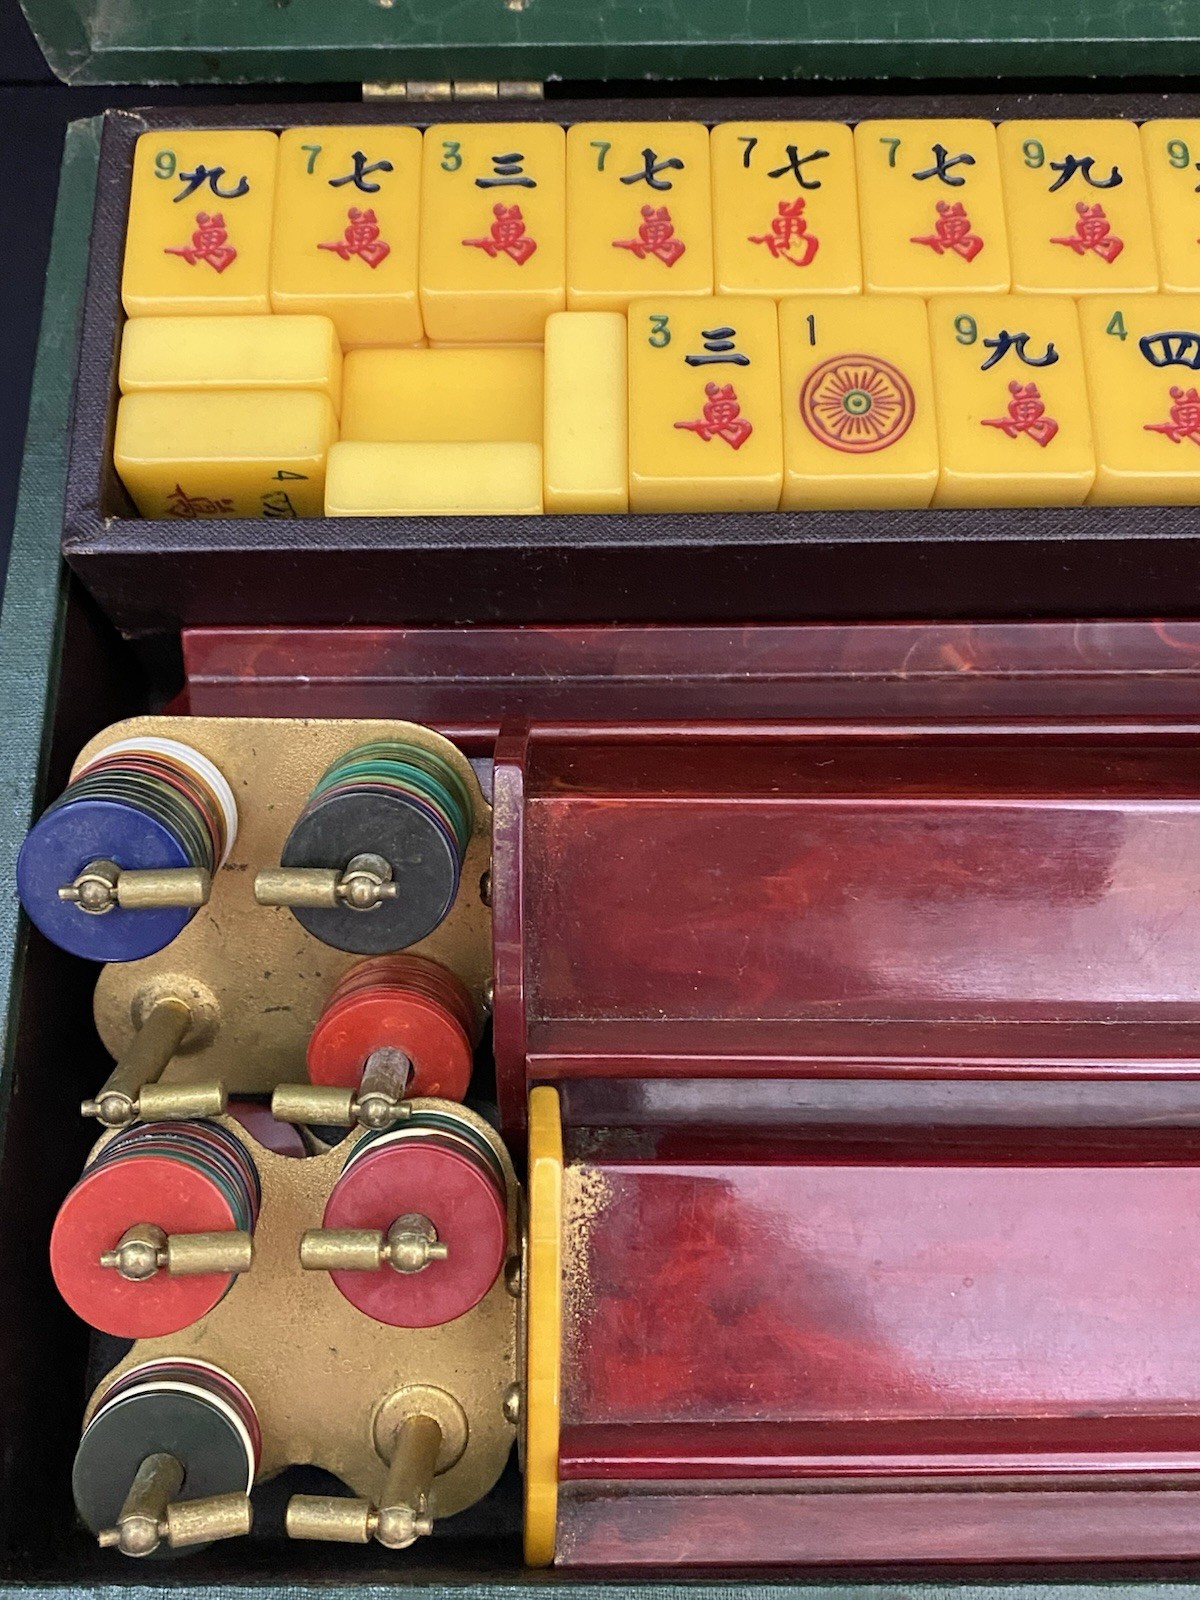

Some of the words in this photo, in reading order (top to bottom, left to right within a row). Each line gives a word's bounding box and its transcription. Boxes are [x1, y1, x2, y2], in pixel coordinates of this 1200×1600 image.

[154, 150, 177, 180] 9
[301, 145, 323, 174] 7
[440, 141, 463, 172] 3
[589, 141, 612, 172] 7
[738, 137, 758, 169] 7
[880, 138, 901, 168] 7
[1022, 139, 1045, 169] 9
[1166, 139, 1190, 169] 9
[648, 315, 672, 348] 3
[953, 314, 978, 345] 9
[1106, 311, 1128, 341] 4
